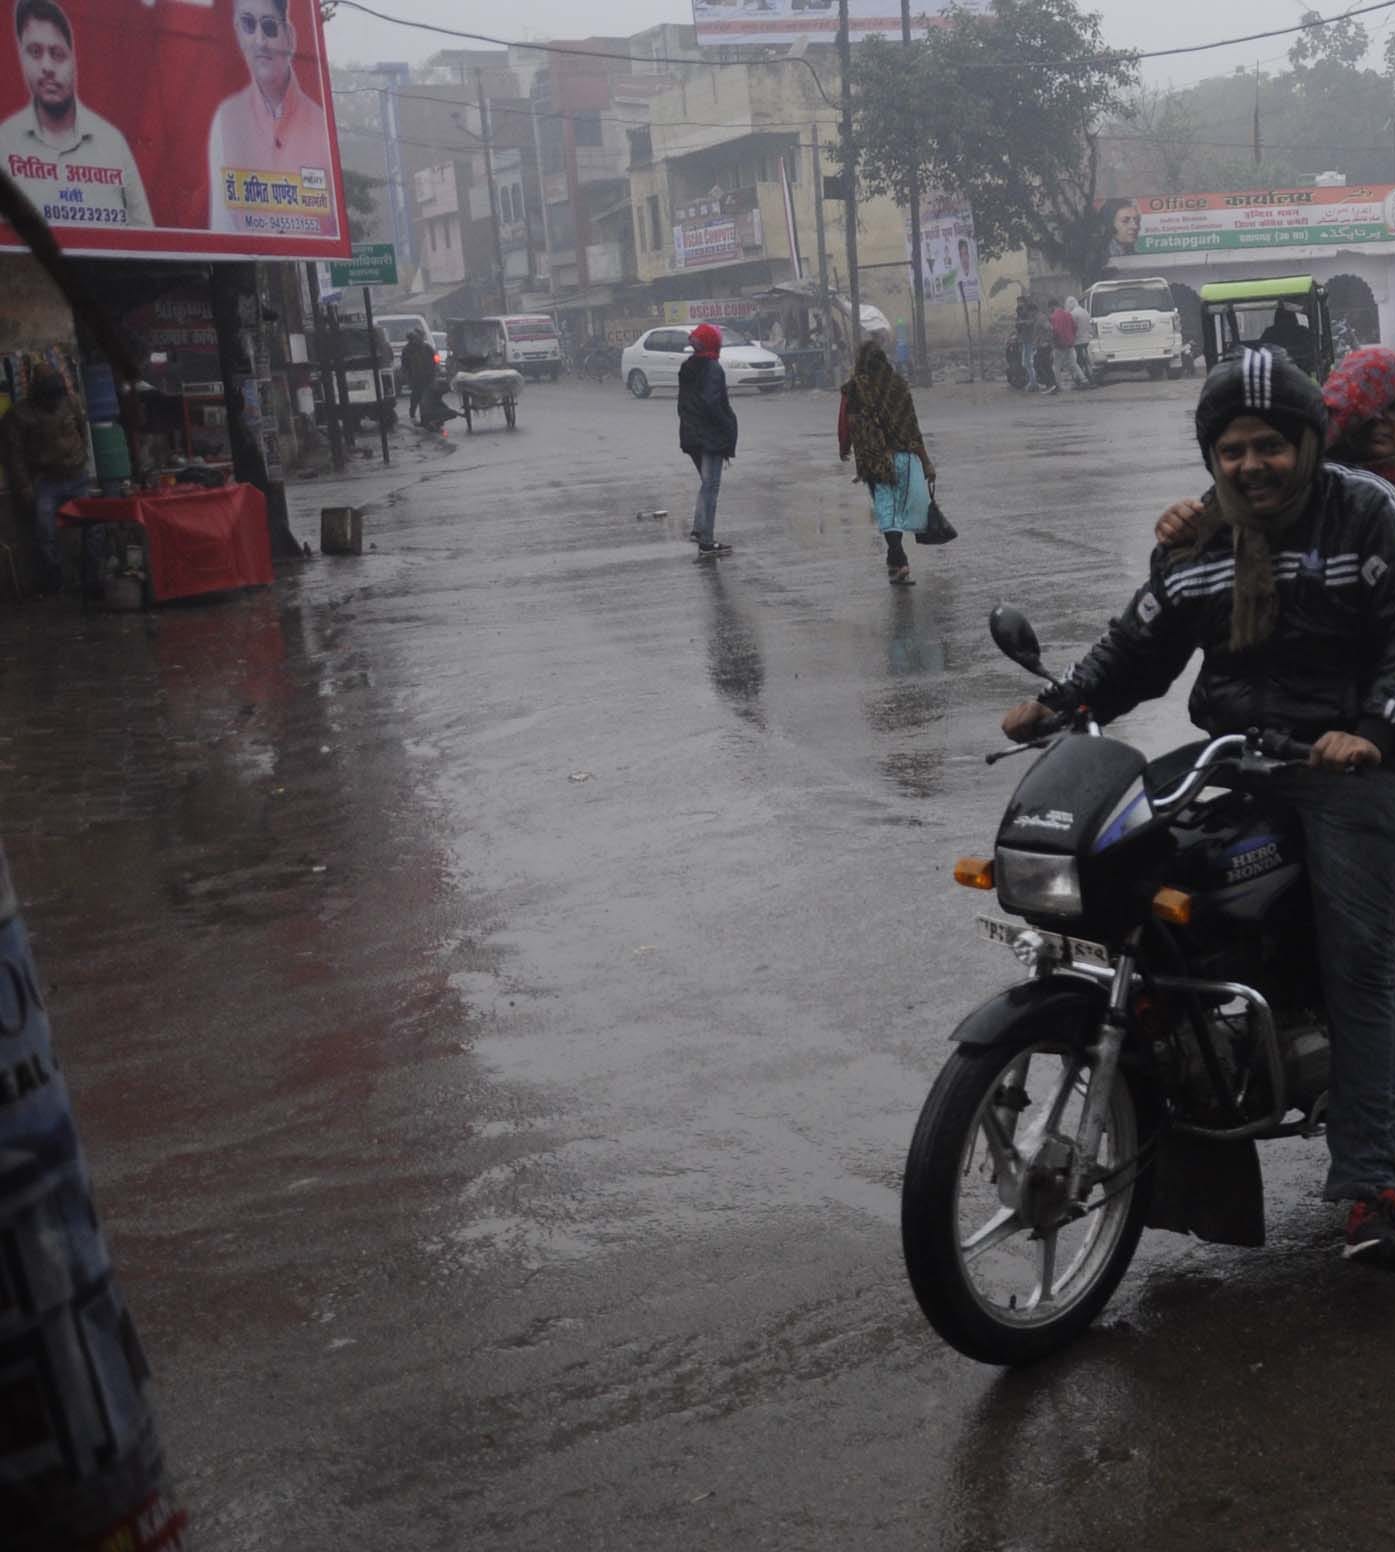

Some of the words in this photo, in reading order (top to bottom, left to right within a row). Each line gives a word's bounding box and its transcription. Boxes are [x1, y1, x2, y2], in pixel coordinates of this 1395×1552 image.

[9, 154, 58, 180] नितिन
[65, 163, 123, 185] अग्रवाल
[1150, 197, 1207, 211] Office
[1224, 190, 1314, 207] कार्यालय
[44, 205, 127, 223] 8052232323
[1226, 852, 1284, 883] HONDA
[1232, 843, 1278, 870] HERO
